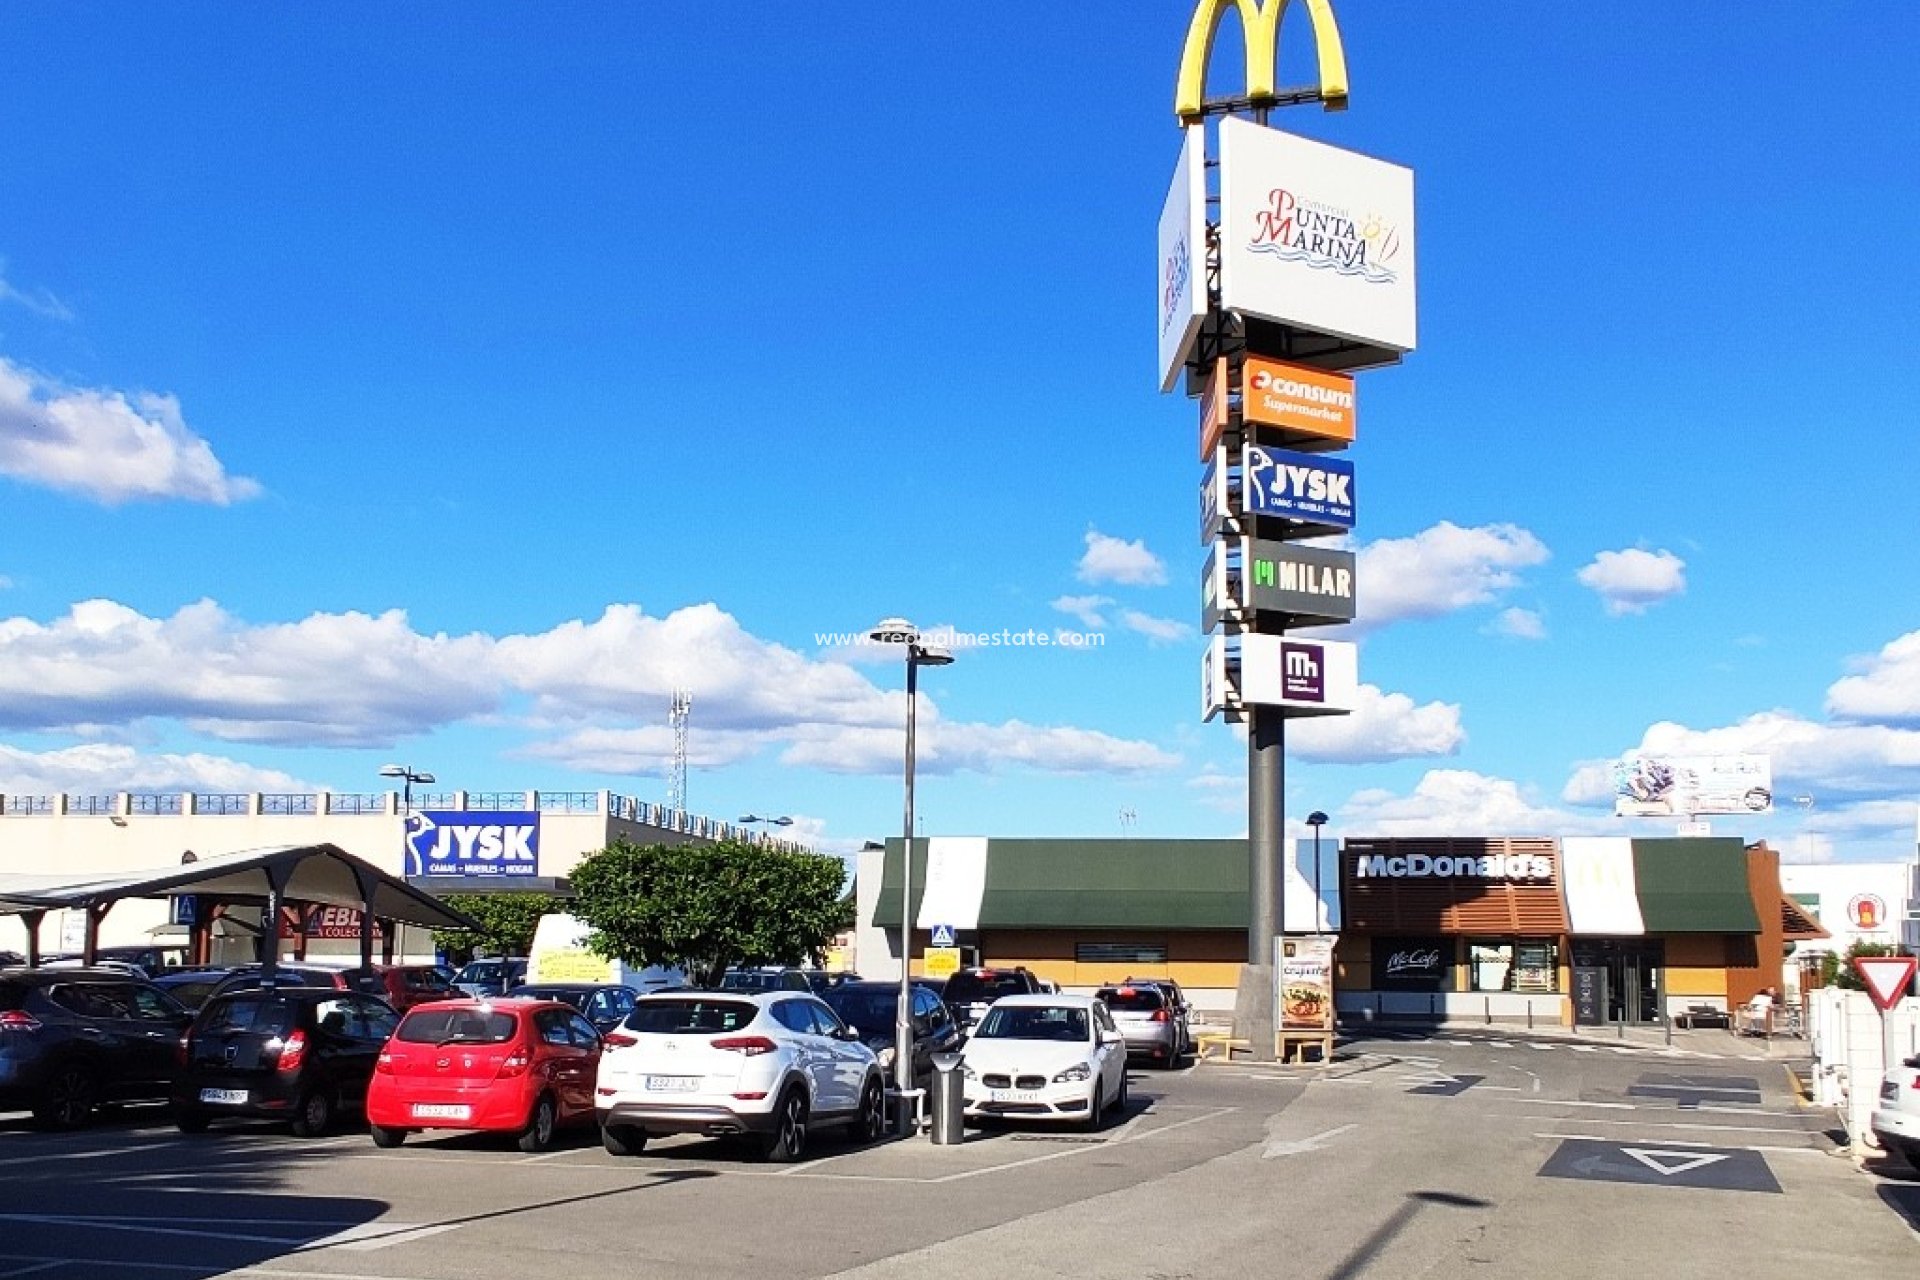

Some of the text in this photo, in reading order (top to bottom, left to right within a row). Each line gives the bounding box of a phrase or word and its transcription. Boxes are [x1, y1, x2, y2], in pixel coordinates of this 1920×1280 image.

[1269, 188, 1356, 240] PUNTA
[1252, 211, 1366, 267] MARINA
[1263, 394, 1343, 422] Supermarket
[1272, 377, 1353, 408] consum
[1270, 464, 1351, 506] JYSK
[1278, 560, 1351, 598] MILAR
[429, 825, 535, 860] JYSK
[1357, 853, 1552, 879] McDonald's
